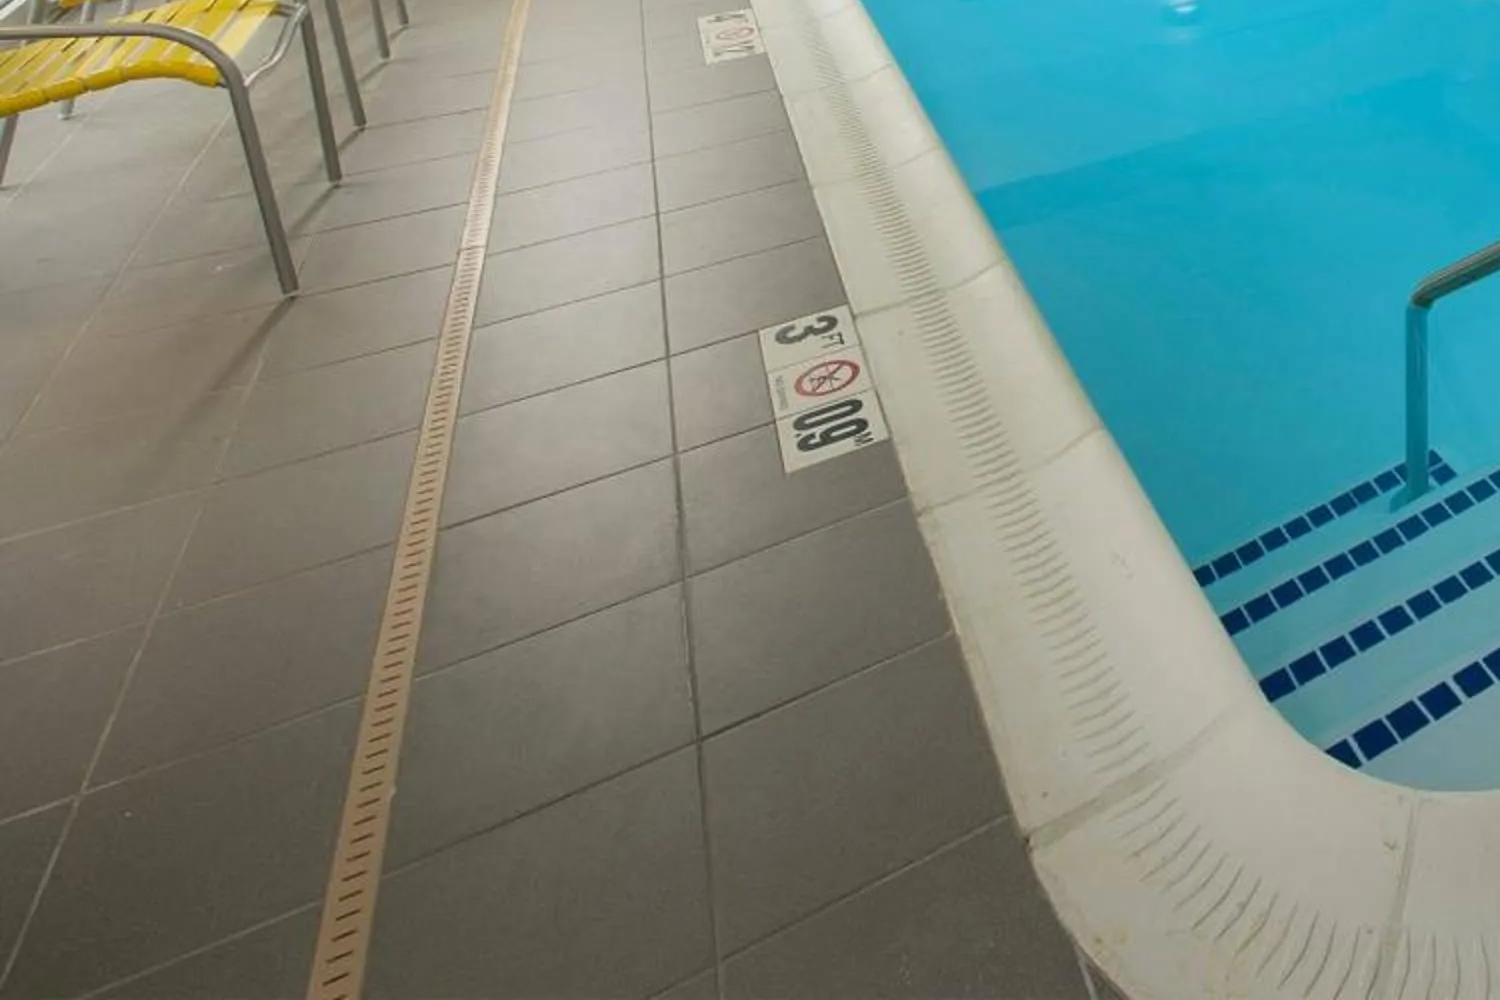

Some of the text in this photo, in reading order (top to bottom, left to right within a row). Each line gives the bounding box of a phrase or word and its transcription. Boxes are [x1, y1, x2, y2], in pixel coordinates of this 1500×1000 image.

[775, 315, 845, 349] 3 FT
[792, 399, 869, 452] 0.9
